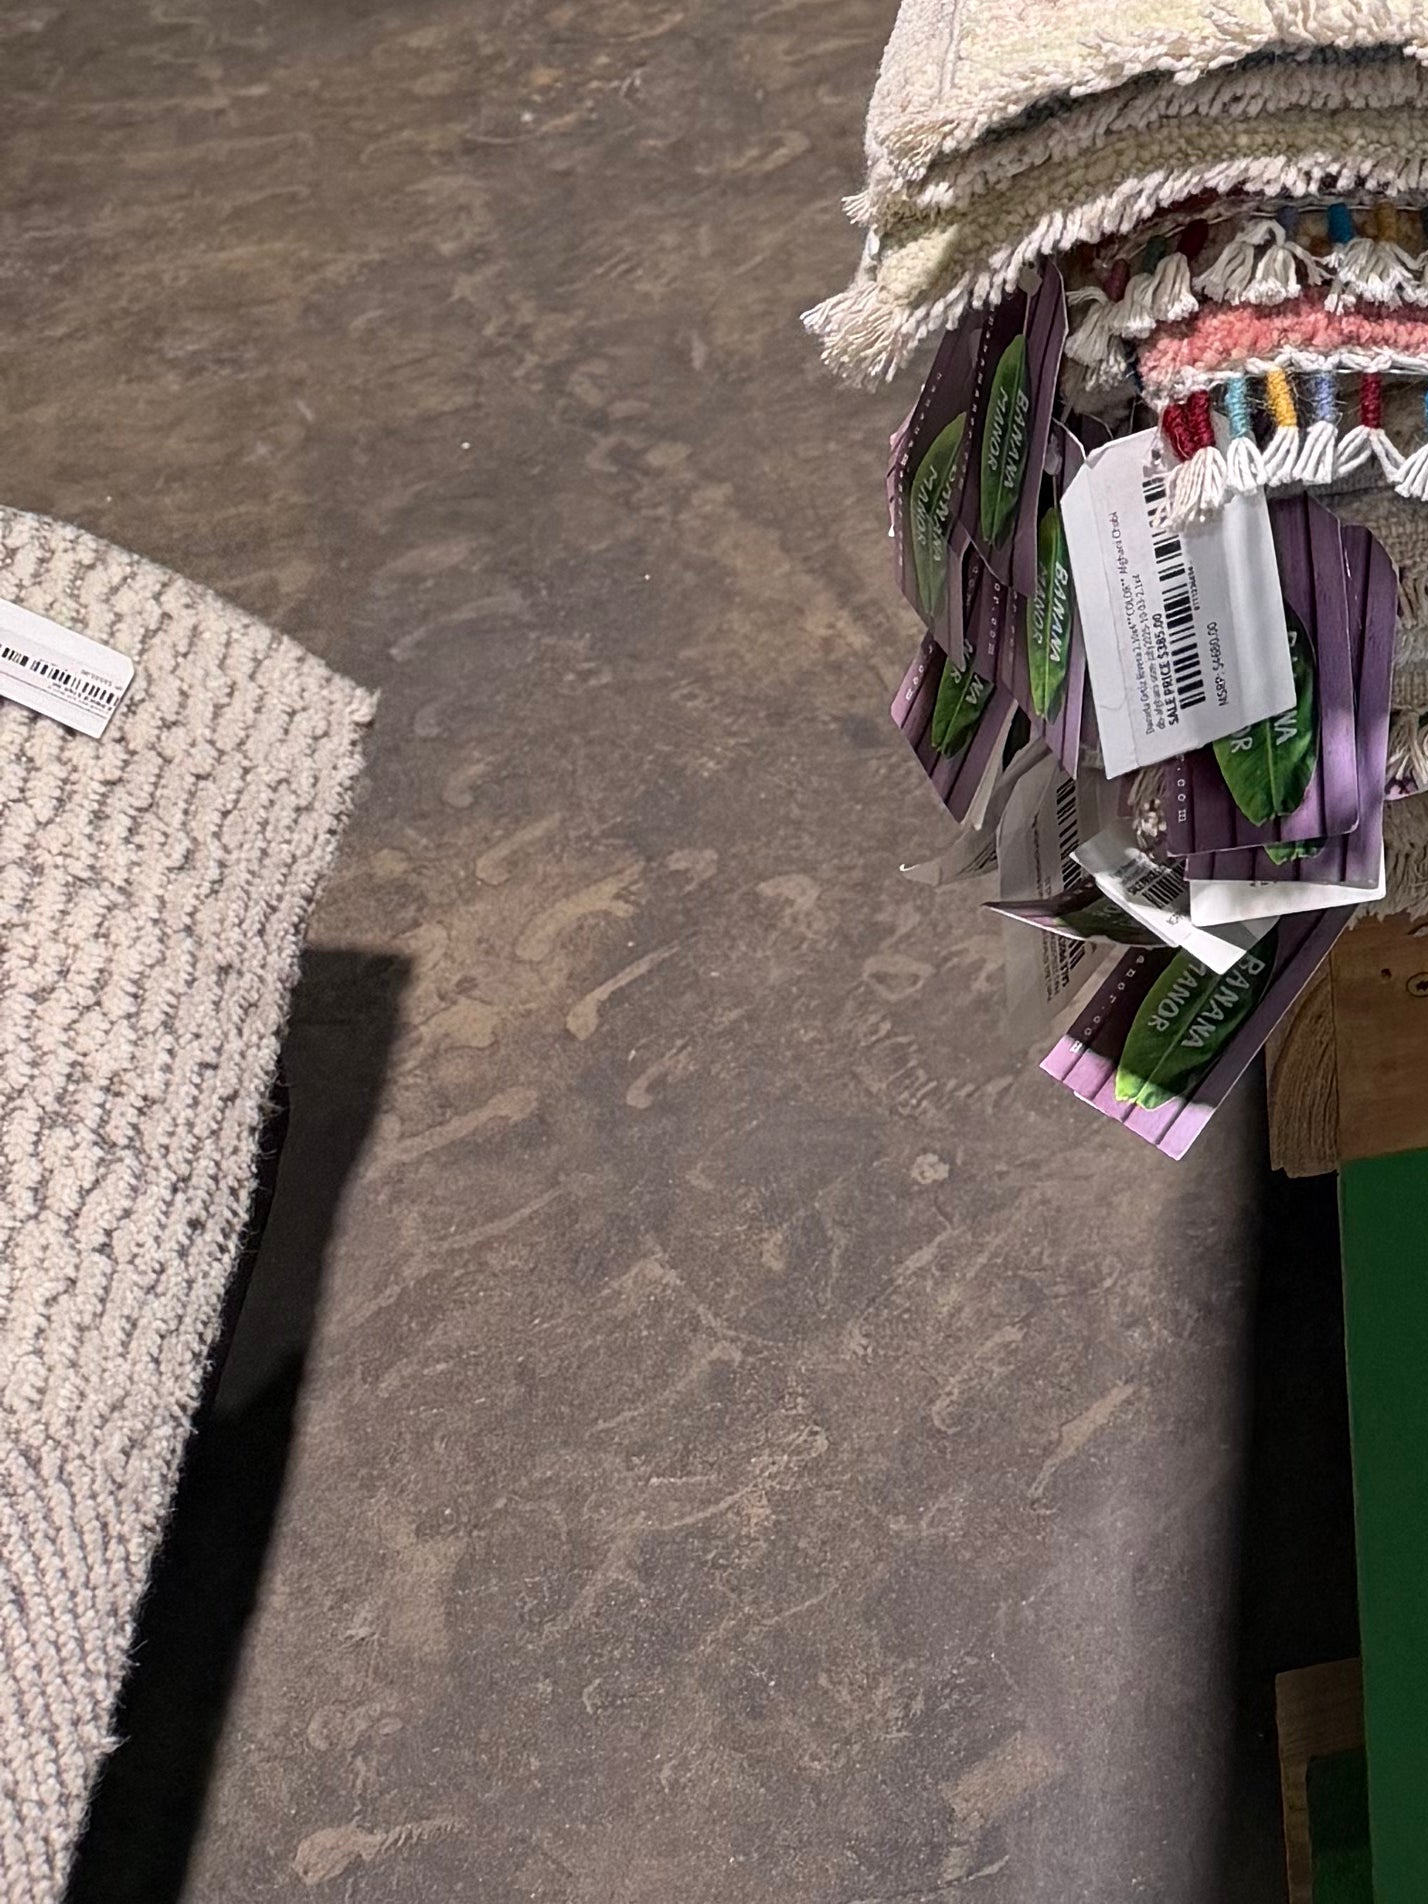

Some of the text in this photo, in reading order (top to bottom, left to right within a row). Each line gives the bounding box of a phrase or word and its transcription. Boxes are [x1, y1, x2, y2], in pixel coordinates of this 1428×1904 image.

[988, 386, 1008, 471] MANOR
[1004, 389, 1029, 489] BANANA
[1050, 561, 1068, 662] BANANA
[1158, 660, 1174, 695] PRICE
[1164, 697, 1179, 725] SALE
[1181, 954, 1266, 1047] BANANA
